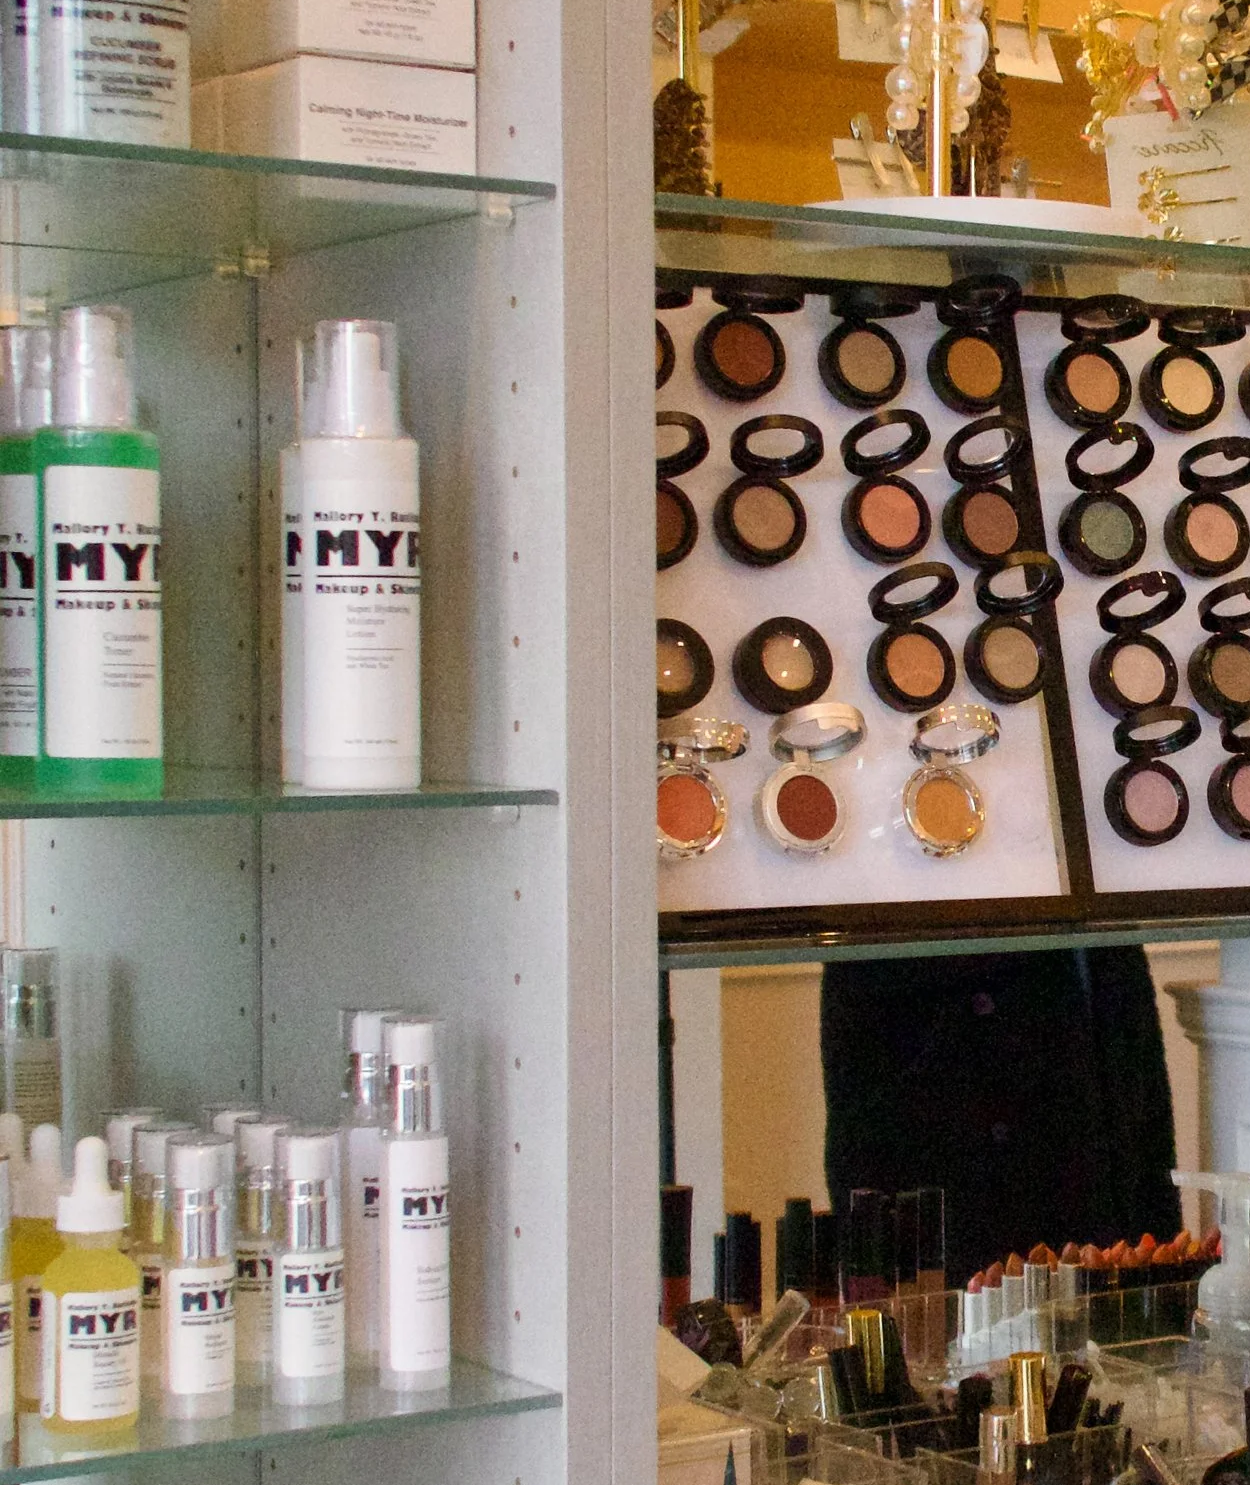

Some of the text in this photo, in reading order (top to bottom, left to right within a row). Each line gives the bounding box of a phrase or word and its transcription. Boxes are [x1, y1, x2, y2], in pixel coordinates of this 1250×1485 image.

[309, 103, 468, 127] Calming Night-Time Moisturizer
[314, 512, 386, 523] Mallory Y.
[52, 523, 131, 535] Mallory Y.
[316, 583, 384, 596] Makeup &
[56, 599, 132, 611] Makeup &
[403, 1194, 450, 1216] MY
[182, 1289, 234, 1312] MY
[69, 1310, 136, 1335] MYR
